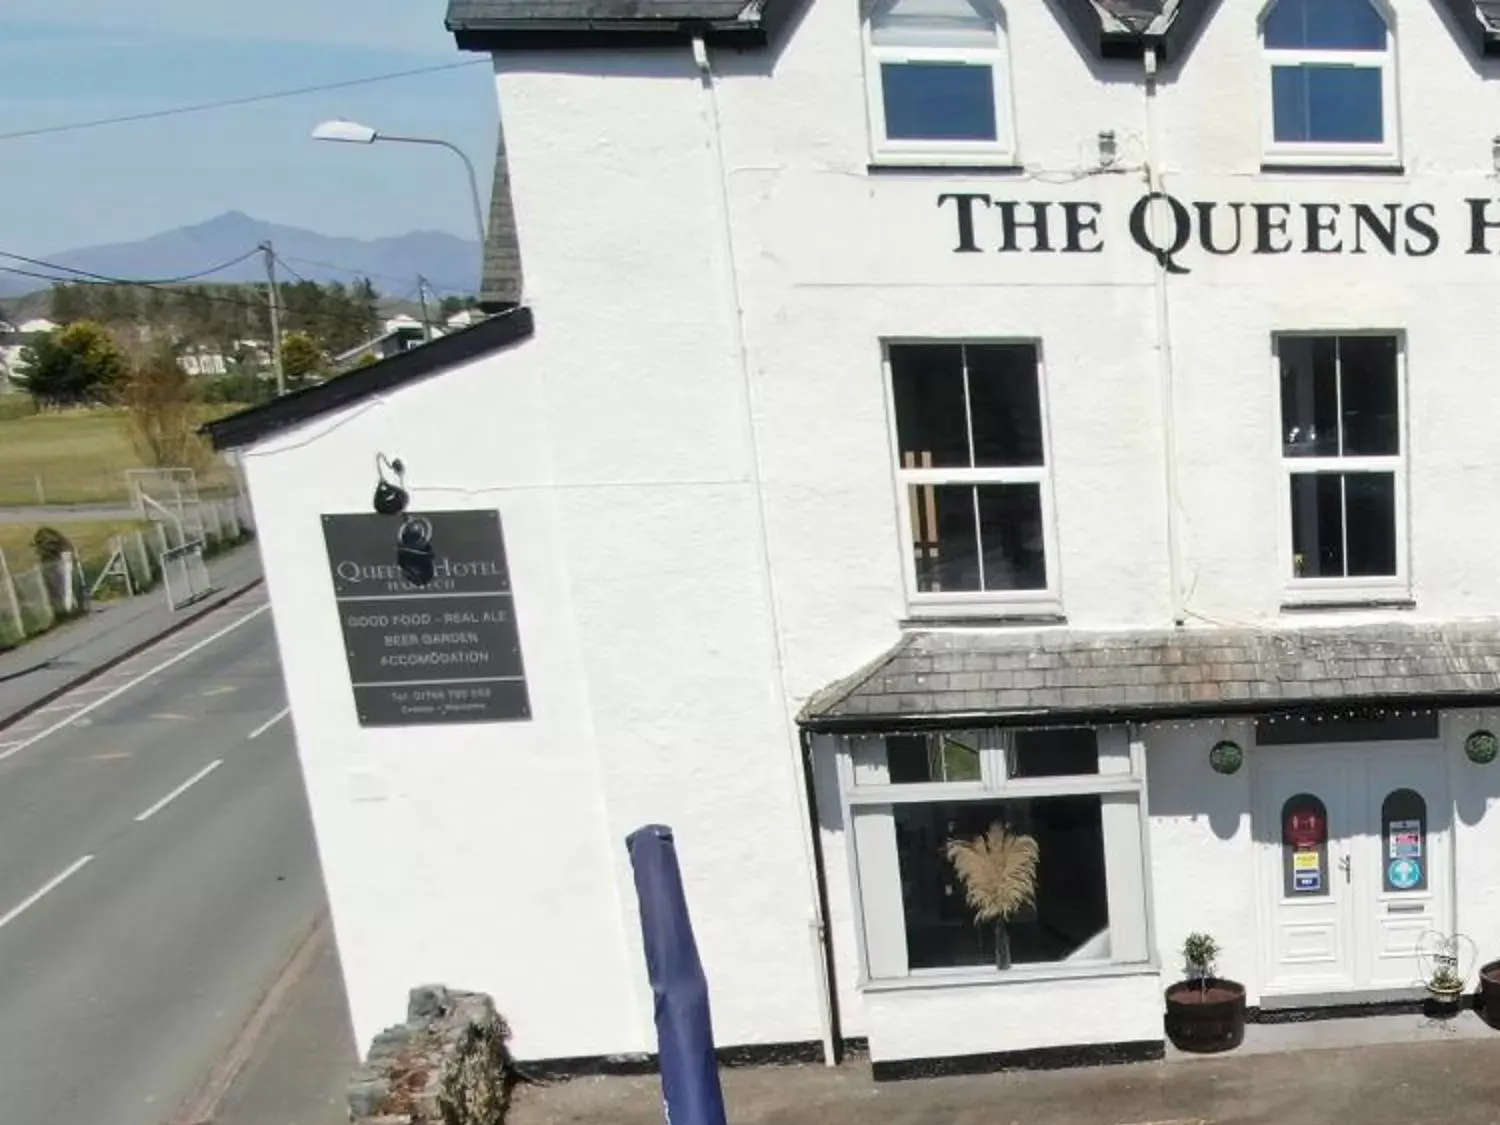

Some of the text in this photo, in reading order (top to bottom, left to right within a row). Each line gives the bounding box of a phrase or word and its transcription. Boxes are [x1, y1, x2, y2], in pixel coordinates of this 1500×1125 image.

[937, 193, 1104, 253] THE
[1129, 192, 1440, 274] QUEENS
[432, 557, 503, 577] HOTEL
[348, 614, 389, 627] GOOD
[392, 612, 432, 625] FOOD
[443, 611, 480, 624] REAL
[483, 609, 507, 622] ALE
[384, 631, 479, 647] BEER GARDEN
